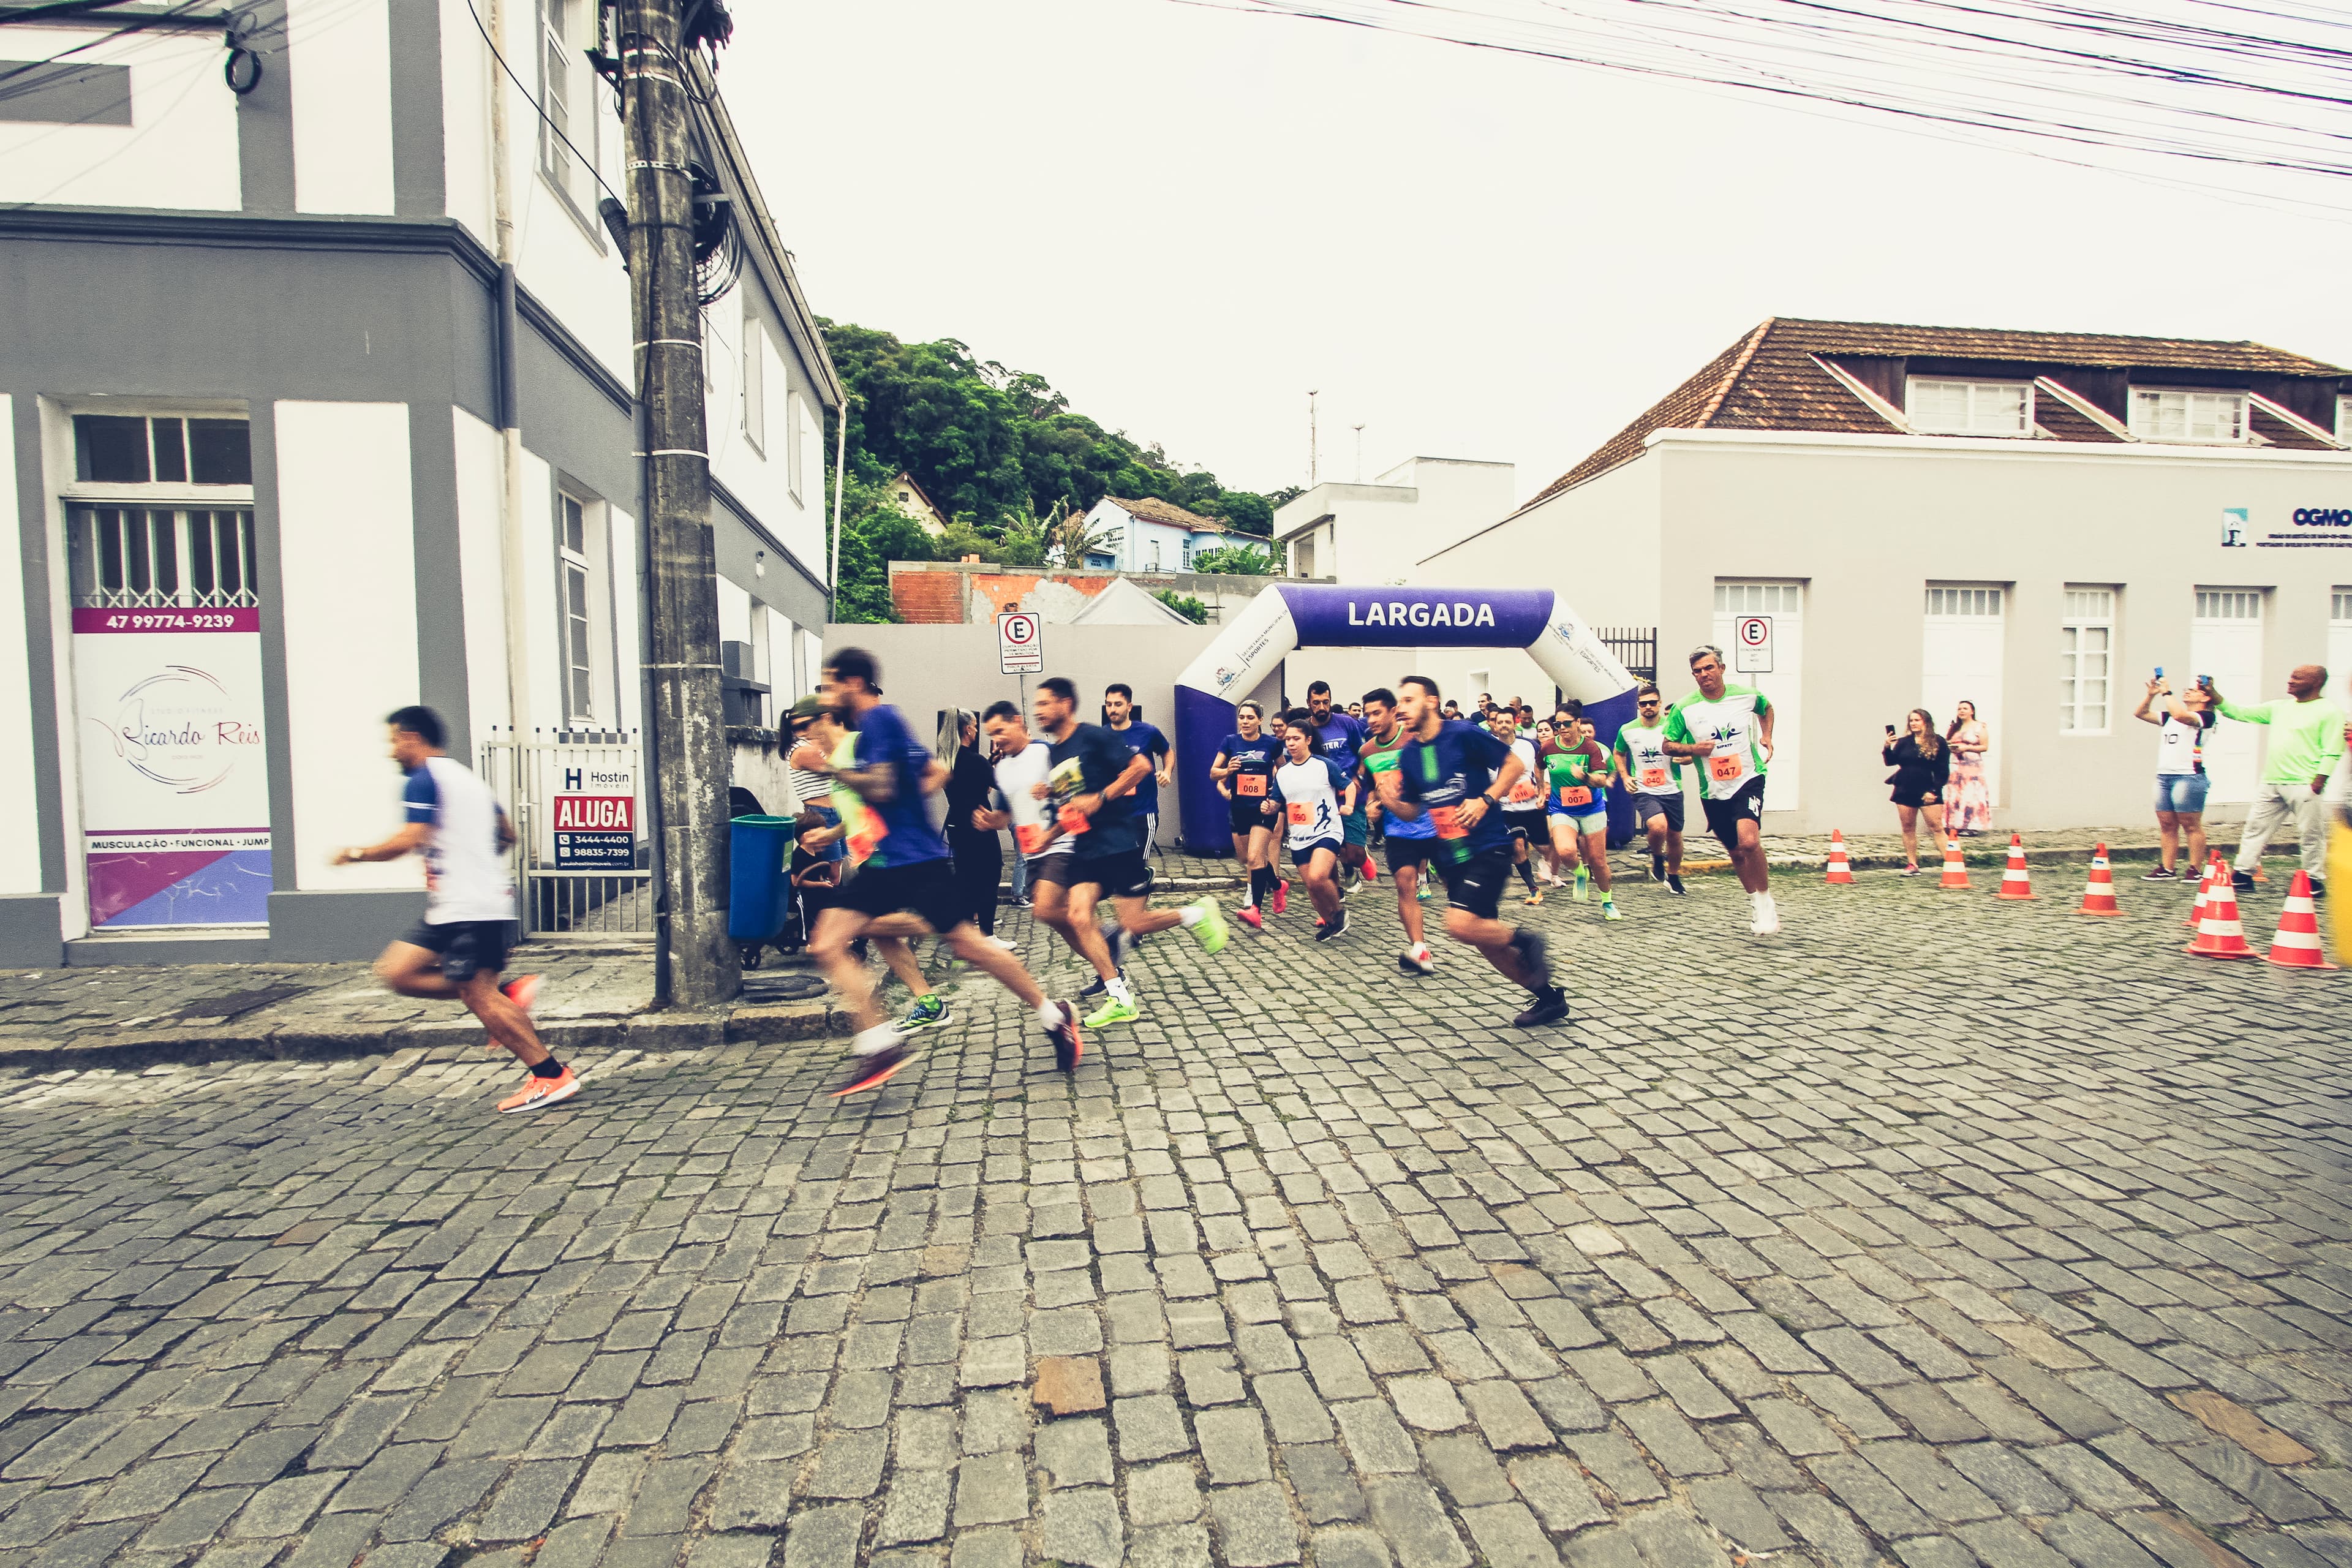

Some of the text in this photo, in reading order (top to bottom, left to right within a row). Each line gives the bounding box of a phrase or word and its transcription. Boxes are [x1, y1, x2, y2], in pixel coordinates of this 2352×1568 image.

[2293, 508, 2352, 527] OGMO
[107, 614, 235, 628] 47 99774-9239
[1348, 601, 1495, 627] LARGADA
[1014, 622, 1025, 638] E
[1749, 624, 1758, 639] E
[1246, 638, 1269, 662] ESPORTES
[213, 721, 260, 745] Reis
[565, 767, 582, 790] H
[591, 771, 628, 783] Hostin
[1717, 767, 1735, 777] 047
[1243, 785, 1259, 793] 008
[559, 800, 628, 827] ALUGA
[91, 839, 168, 850] MUSCULAÇÃO
[175, 839, 234, 848] FUNCIONAL
[575, 835, 629, 844] 3444-4400
[574, 848, 630, 857] 98835-7399
